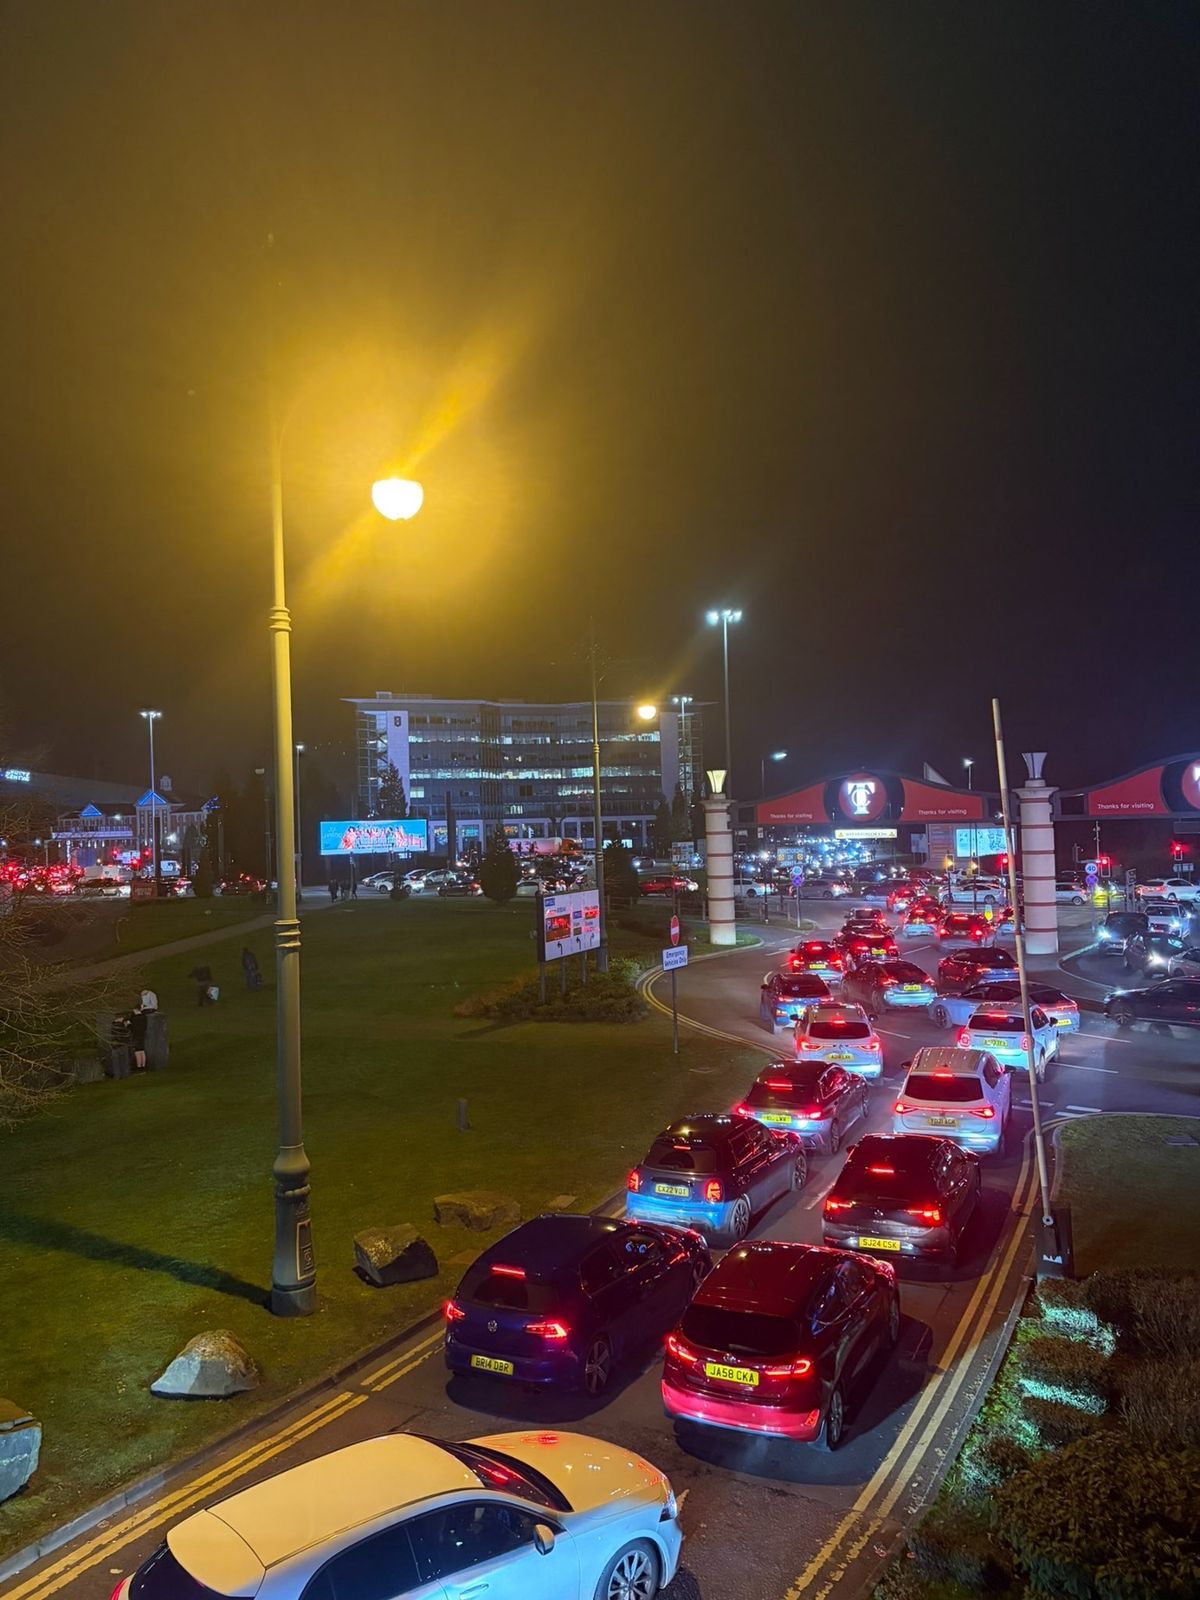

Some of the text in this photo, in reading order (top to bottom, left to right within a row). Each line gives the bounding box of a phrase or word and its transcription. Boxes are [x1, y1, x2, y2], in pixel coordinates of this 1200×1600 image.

[666, 950, 685, 959] Emergency
[664, 957, 687, 967] Vehicles Only
[863, 1239, 897, 1249] SJ24 CSK
[476, 1357, 492, 1369] BR14
[710, 1366, 755, 1383] JA58 CKA
